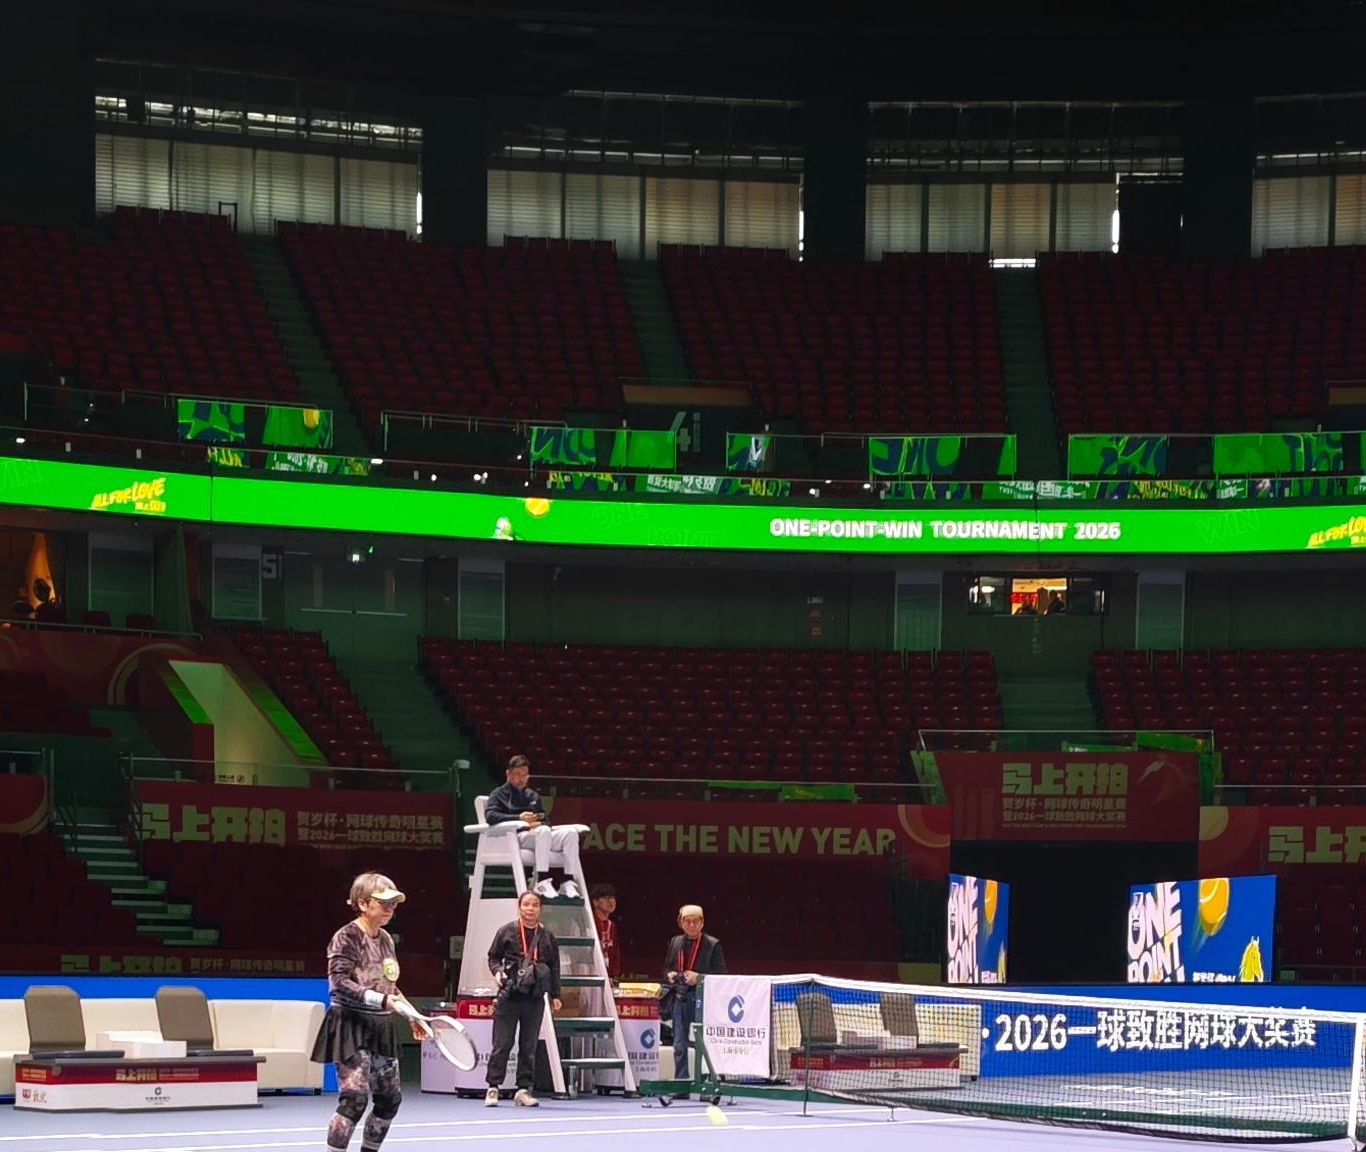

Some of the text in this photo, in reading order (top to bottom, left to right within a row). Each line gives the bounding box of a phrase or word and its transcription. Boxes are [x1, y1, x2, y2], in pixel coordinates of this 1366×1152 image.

[770, 518, 1121, 541] ONE-POINT-WIN TOURNAMENT 2026
[584, 822, 897, 856] ACE THE NEW YEAR
[1128, 881, 1182, 960] ONE
